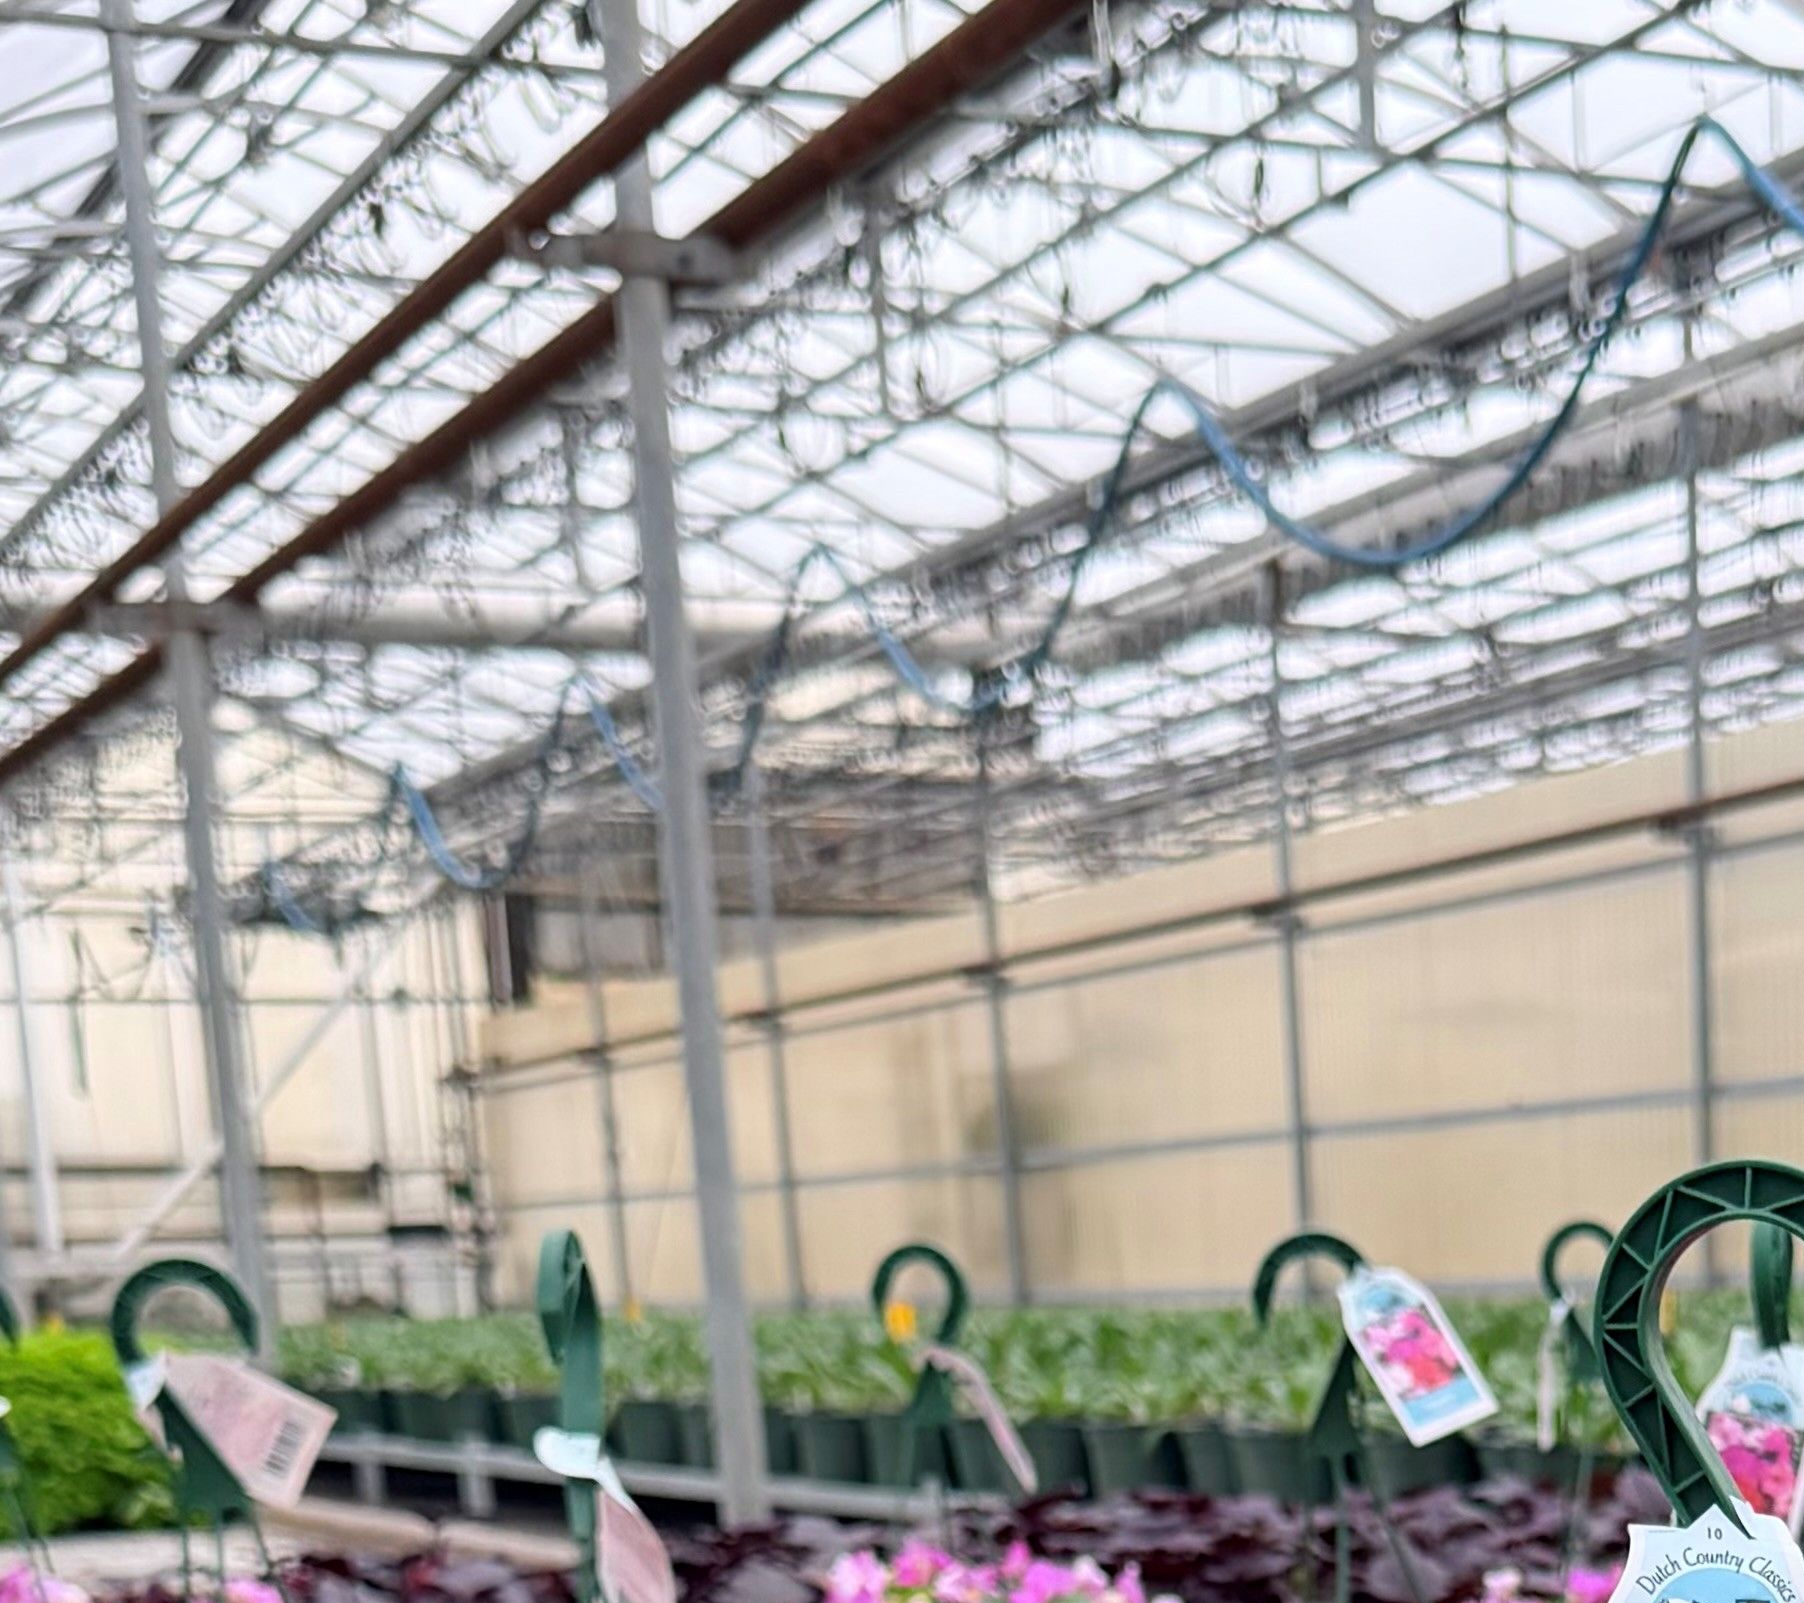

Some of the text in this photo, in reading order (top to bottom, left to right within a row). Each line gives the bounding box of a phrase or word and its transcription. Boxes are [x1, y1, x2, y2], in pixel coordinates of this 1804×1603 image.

[1707, 1527, 1723, 1540] 10
[1635, 1547, 1797, 1603] Dutch Country Classics
